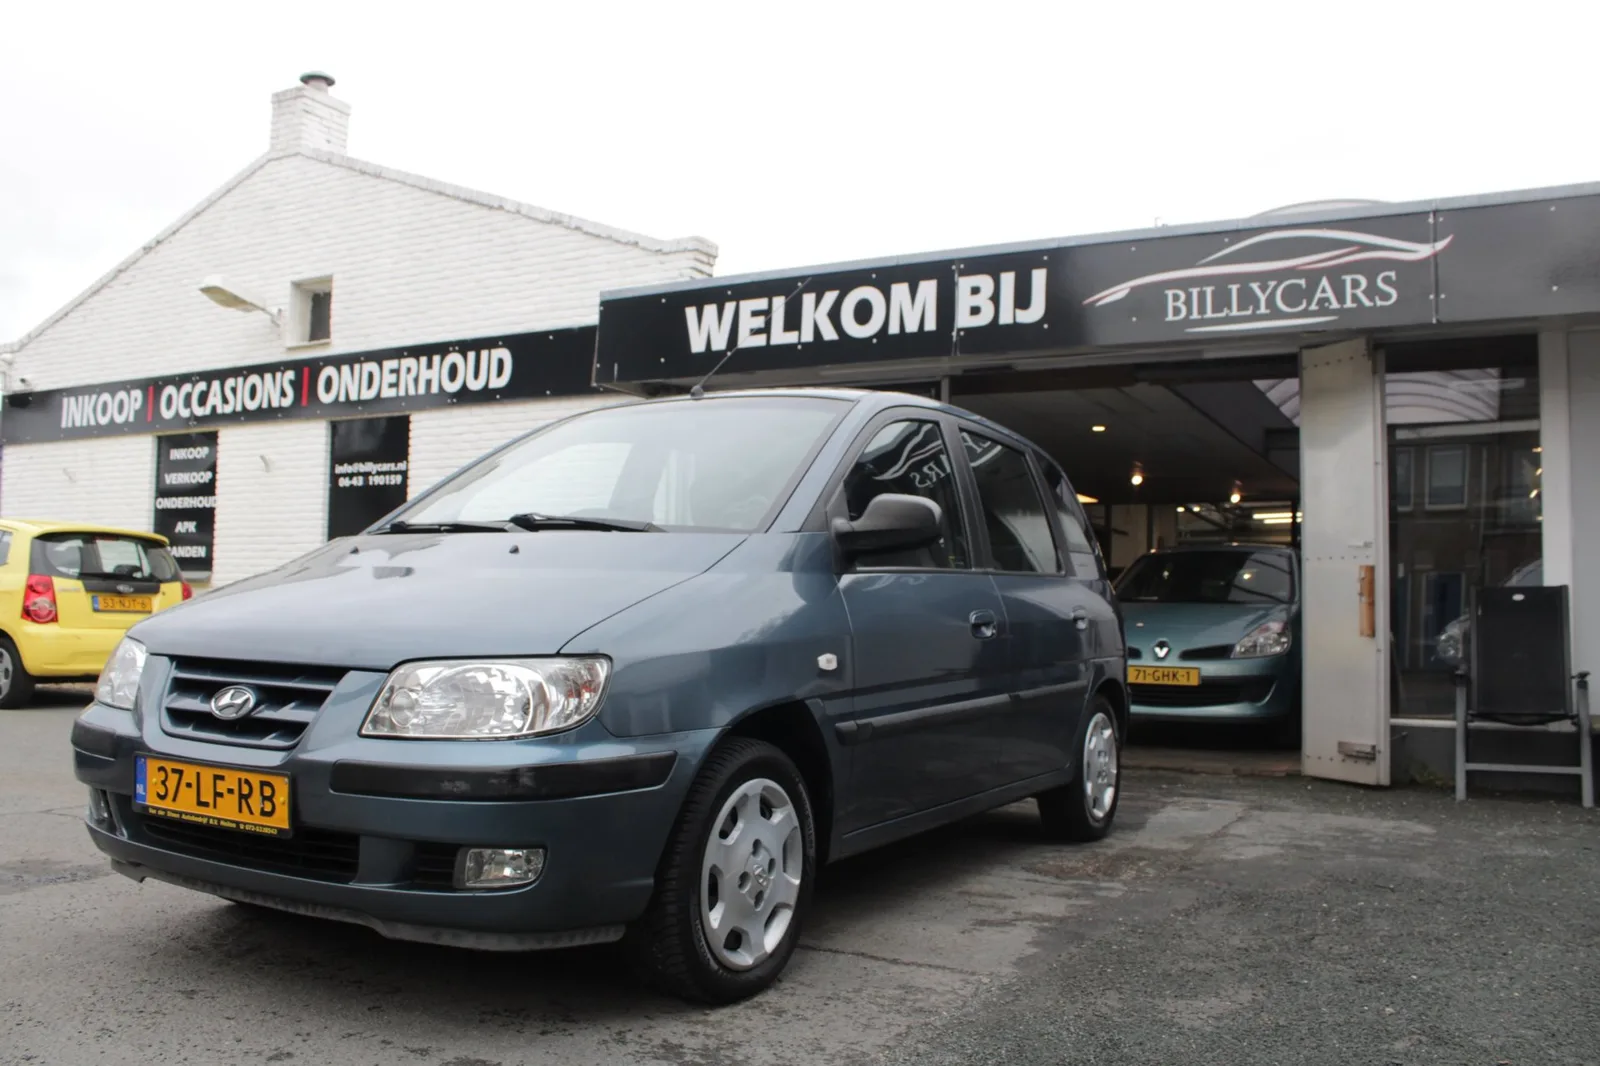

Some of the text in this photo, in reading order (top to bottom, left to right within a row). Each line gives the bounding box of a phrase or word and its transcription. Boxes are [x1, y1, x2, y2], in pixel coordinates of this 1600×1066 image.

[1164, 270, 1398, 322] BILLYCARS
[684, 268, 1047, 354] WELKOM BIJ
[60, 347, 513, 428] INKOOP OCCASIONS ONDERHOUD
[169, 447, 210, 460] INKOOP
[164, 471, 213, 484] VERKOOP
[175, 521, 197, 533] APK
[167, 545, 206, 558] ANDEN
[1134, 669, 1191, 682] 71-GHK-1
[136, 782, 146, 796] NL
[156, 765, 277, 818] 37-LF-RB
